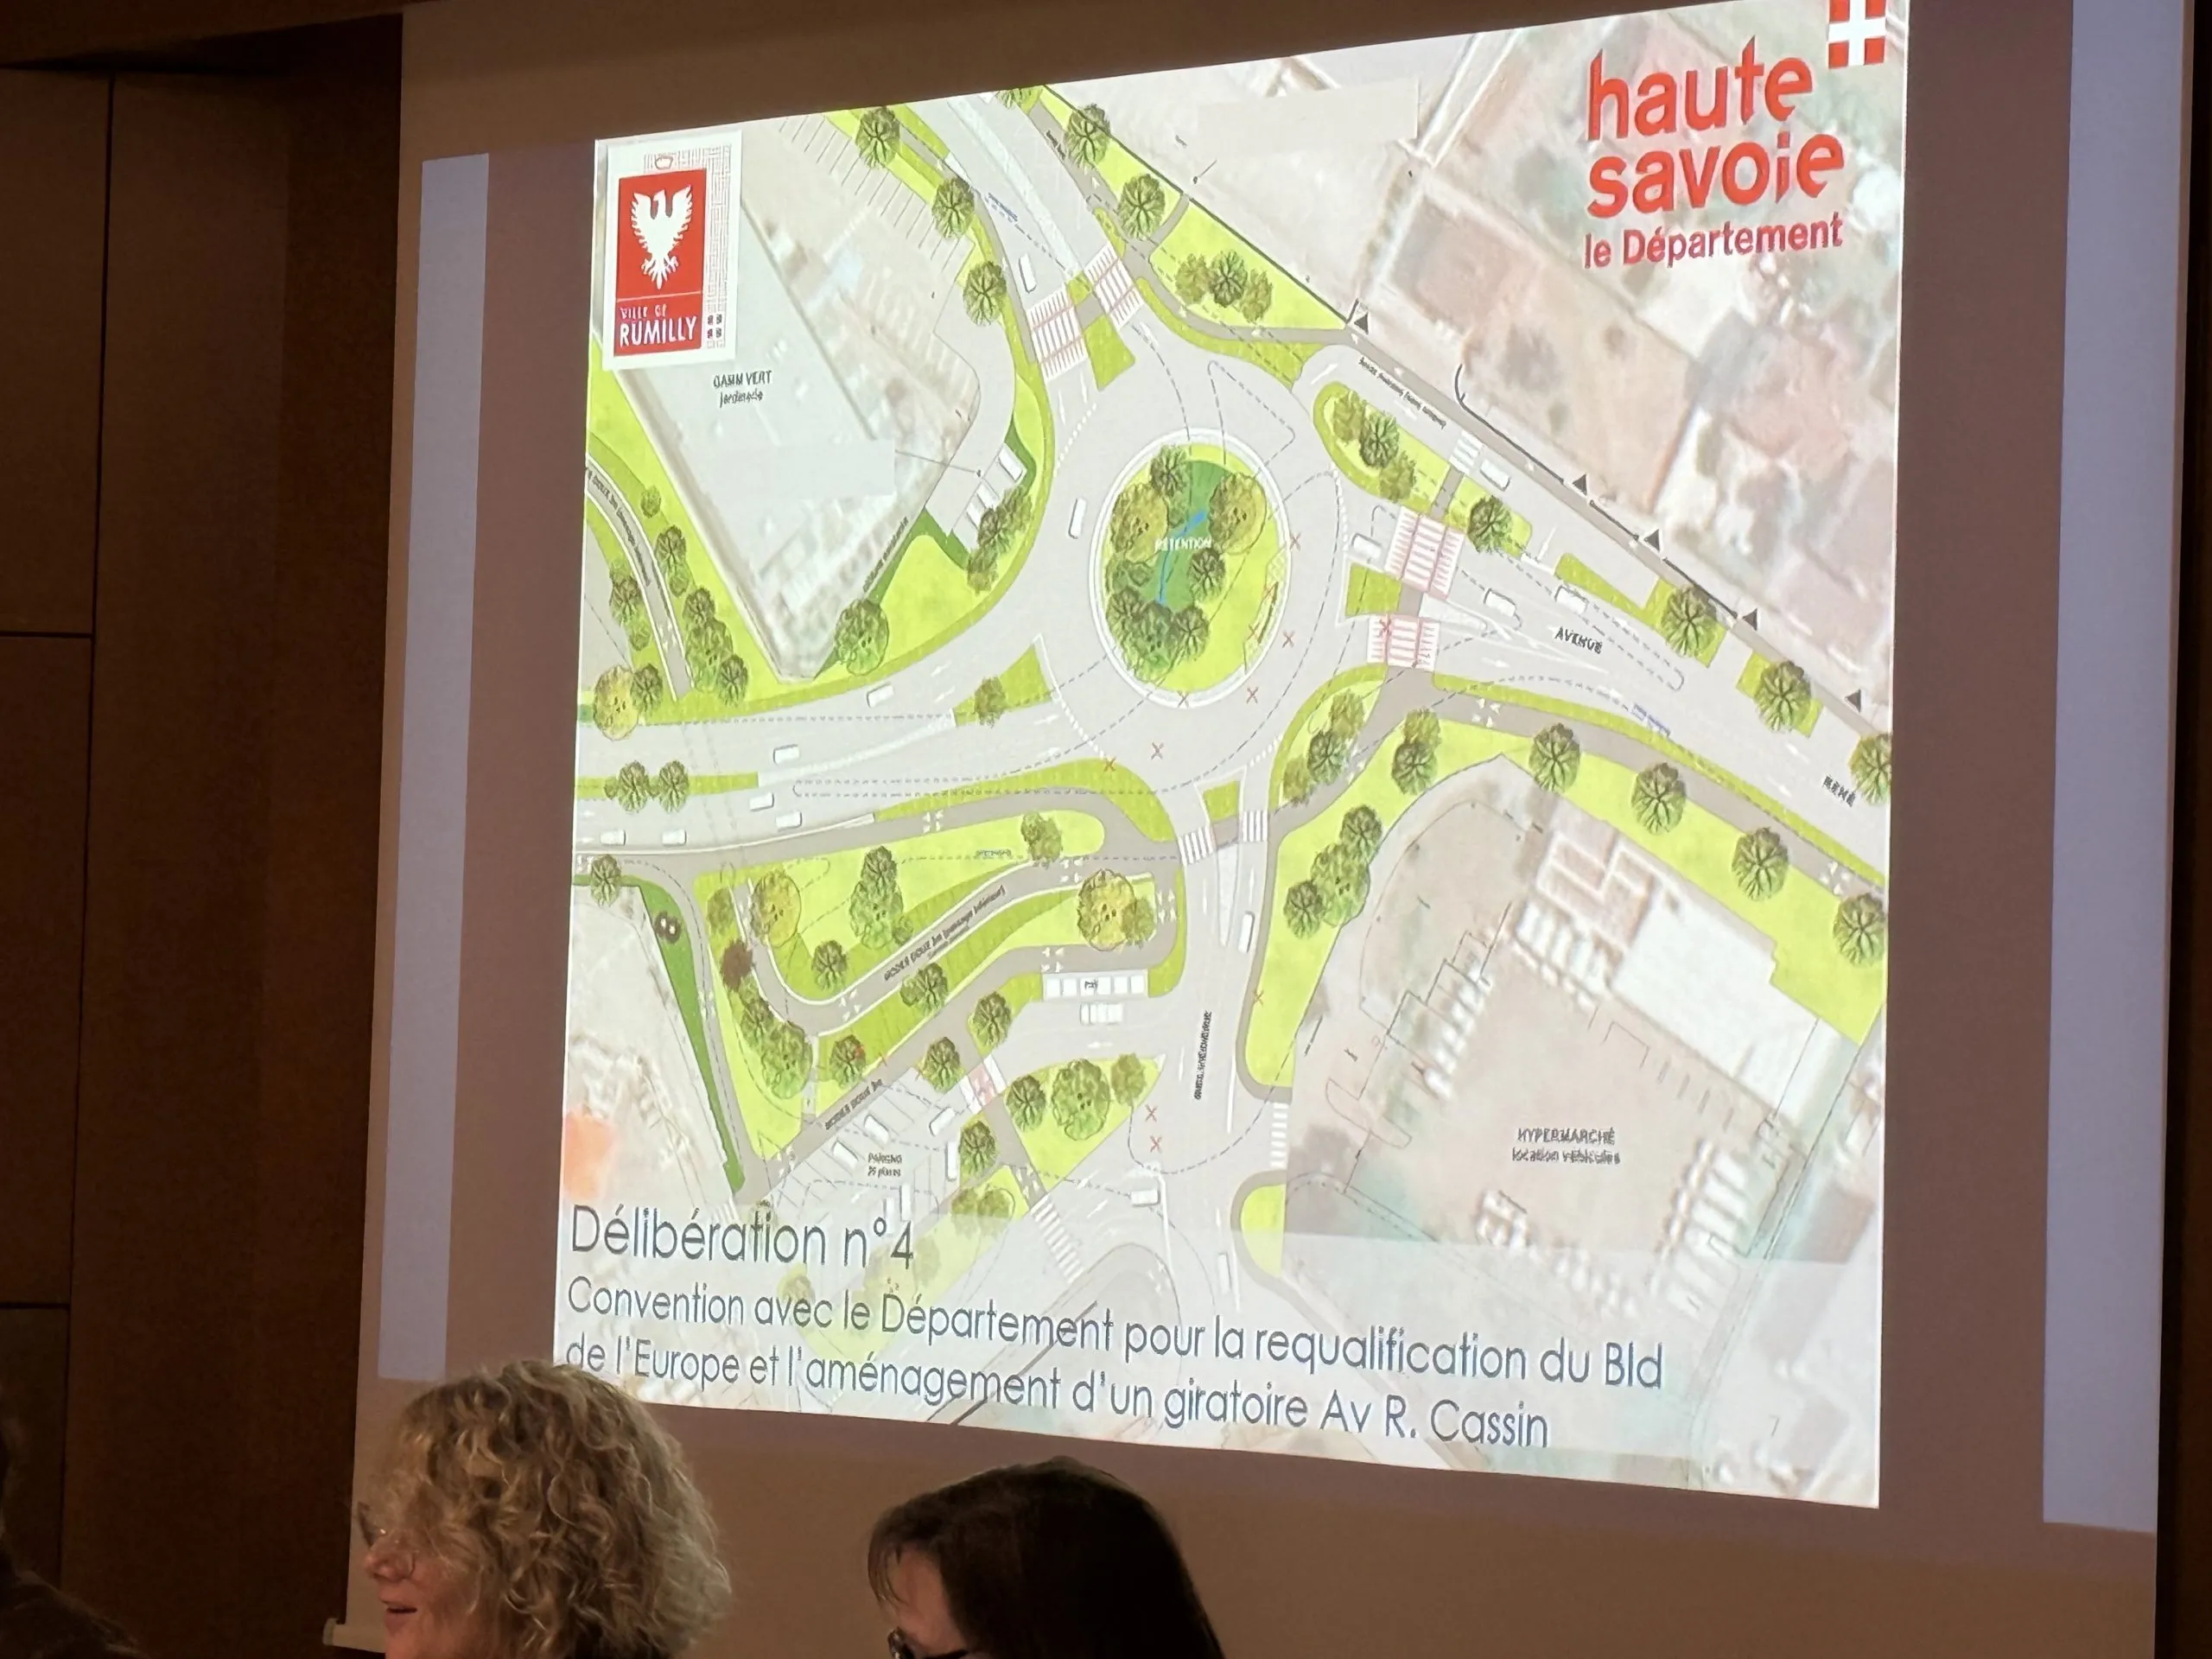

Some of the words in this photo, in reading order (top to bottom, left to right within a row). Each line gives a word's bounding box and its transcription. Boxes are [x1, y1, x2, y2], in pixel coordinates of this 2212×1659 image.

[1587, 35, 1813, 141] haute
[1586, 131, 1845, 219] savoie
[1585, 232, 1611, 269] le
[1623, 211, 1843, 268] Département
[620, 315, 697, 347] RUMILLY
[571, 1203, 826, 1267] Délibération
[568, 1275, 745, 1326] Convention
[754, 1294, 834, 1330] avec
[843, 1292, 871, 1331] le
[881, 1293, 1112, 1351] Département
[1123, 1322, 1206, 1363] pour
[1214, 1314, 1245, 1360] la
[1255, 1324, 1529, 1381] requalification
[1540, 1337, 1589, 1382] du
[1605, 1341, 1663, 1389] Bld
[566, 1334, 606, 1372] de
[617, 1335, 741, 1392] l'Europe
[749, 1345, 779, 1388] et
[788, 1345, 1062, 1412] l'aménagement
[1072, 1370, 1153, 1418] d'un
[1163, 1377, 1309, 1429] giratoire
[1320, 1389, 1370, 1434] Av
[1384, 1395, 1417, 1440] R.
[1430, 1400, 1548, 1449] Cassin
